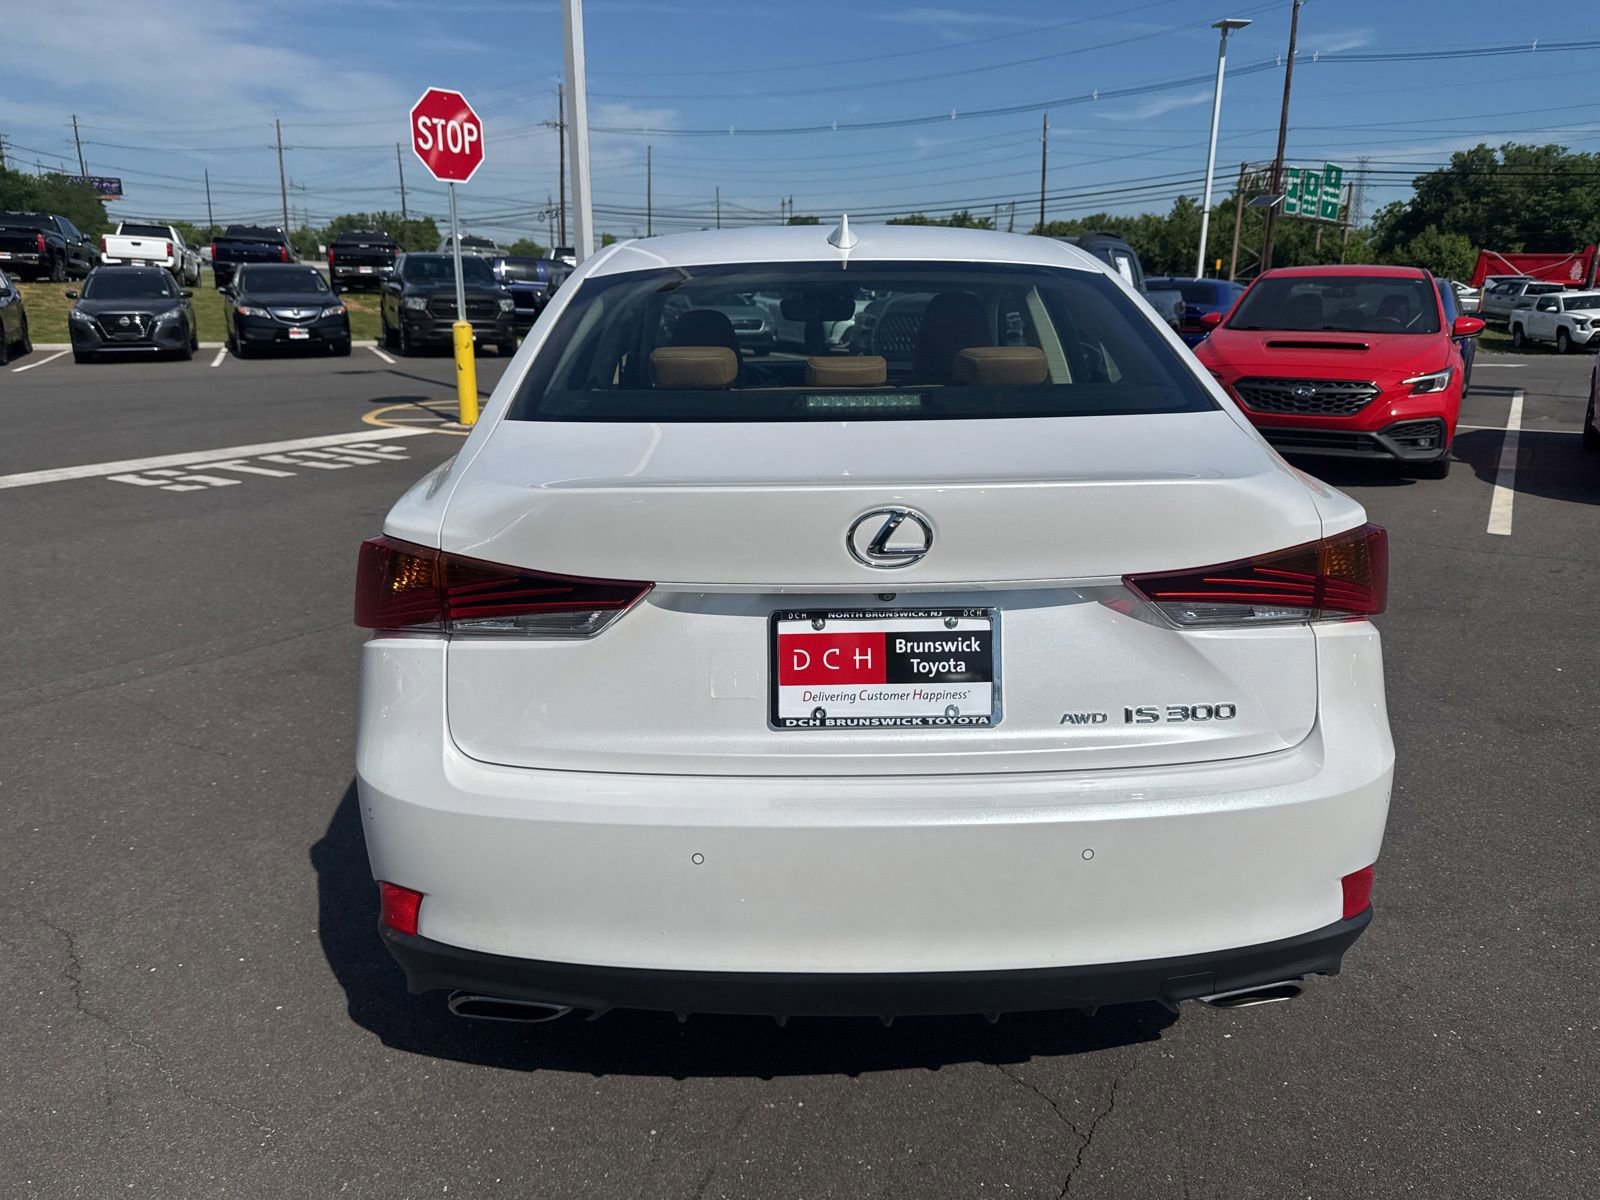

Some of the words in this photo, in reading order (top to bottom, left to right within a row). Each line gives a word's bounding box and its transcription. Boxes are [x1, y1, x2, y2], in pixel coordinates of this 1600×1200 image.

[417, 115, 479, 155] STOP
[828, 611, 863, 619] NORTH
[930, 610, 943, 618] NJ
[895, 637, 981, 654] Brunswick
[793, 647, 872, 671] DCH
[910, 658, 967, 677] Toyota
[803, 690, 857, 704] Delivering
[859, 689, 910, 701] Customer
[785, 719, 821, 727] DCH
[825, 717, 922, 727] BRUNSWICK
[926, 716, 989, 725] TOYOTA
[1059, 712, 1108, 725] AWD
[1123, 704, 1161, 725] IS
[1166, 701, 1237, 723] 300
